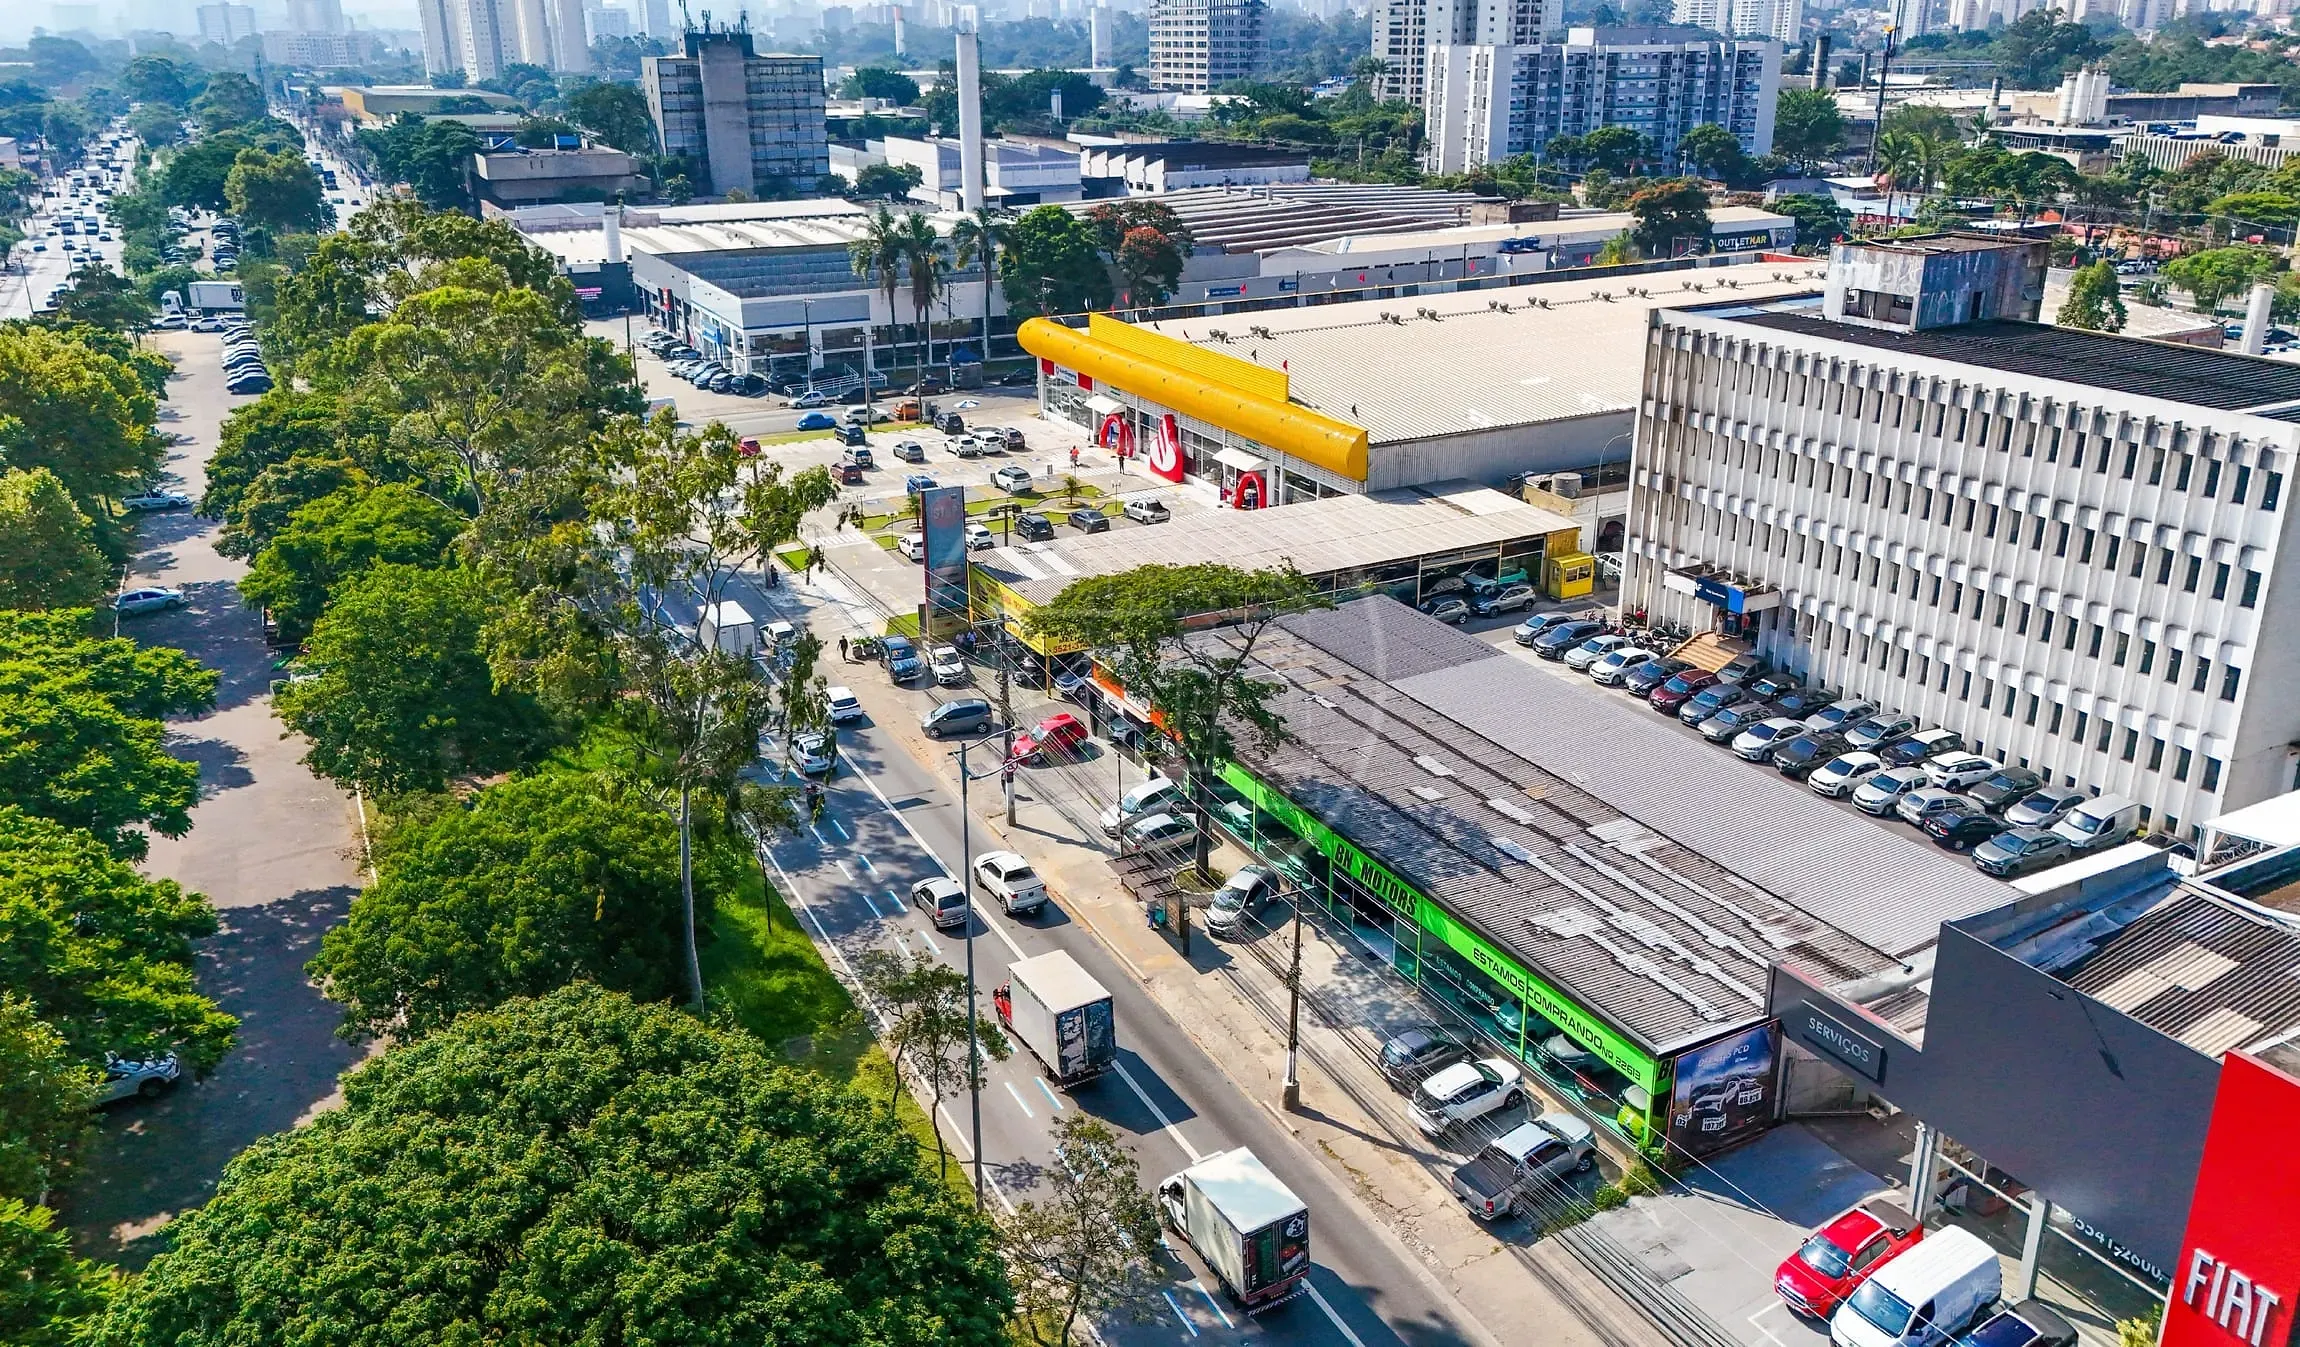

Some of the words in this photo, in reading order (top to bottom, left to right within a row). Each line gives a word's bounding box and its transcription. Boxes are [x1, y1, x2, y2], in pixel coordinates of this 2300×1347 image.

[1334, 842, 1354, 870] BN
[1360, 861, 1417, 915] MOTORS
[1473, 948, 1525, 992] ESTAMOS
[1527, 986, 1603, 1049] COMPRANDO
[1733, 1044, 1750, 1056] PCD
[1808, 1017, 1869, 1062] SERVIÇOS
[2184, 1248, 2280, 1347] FIAT
